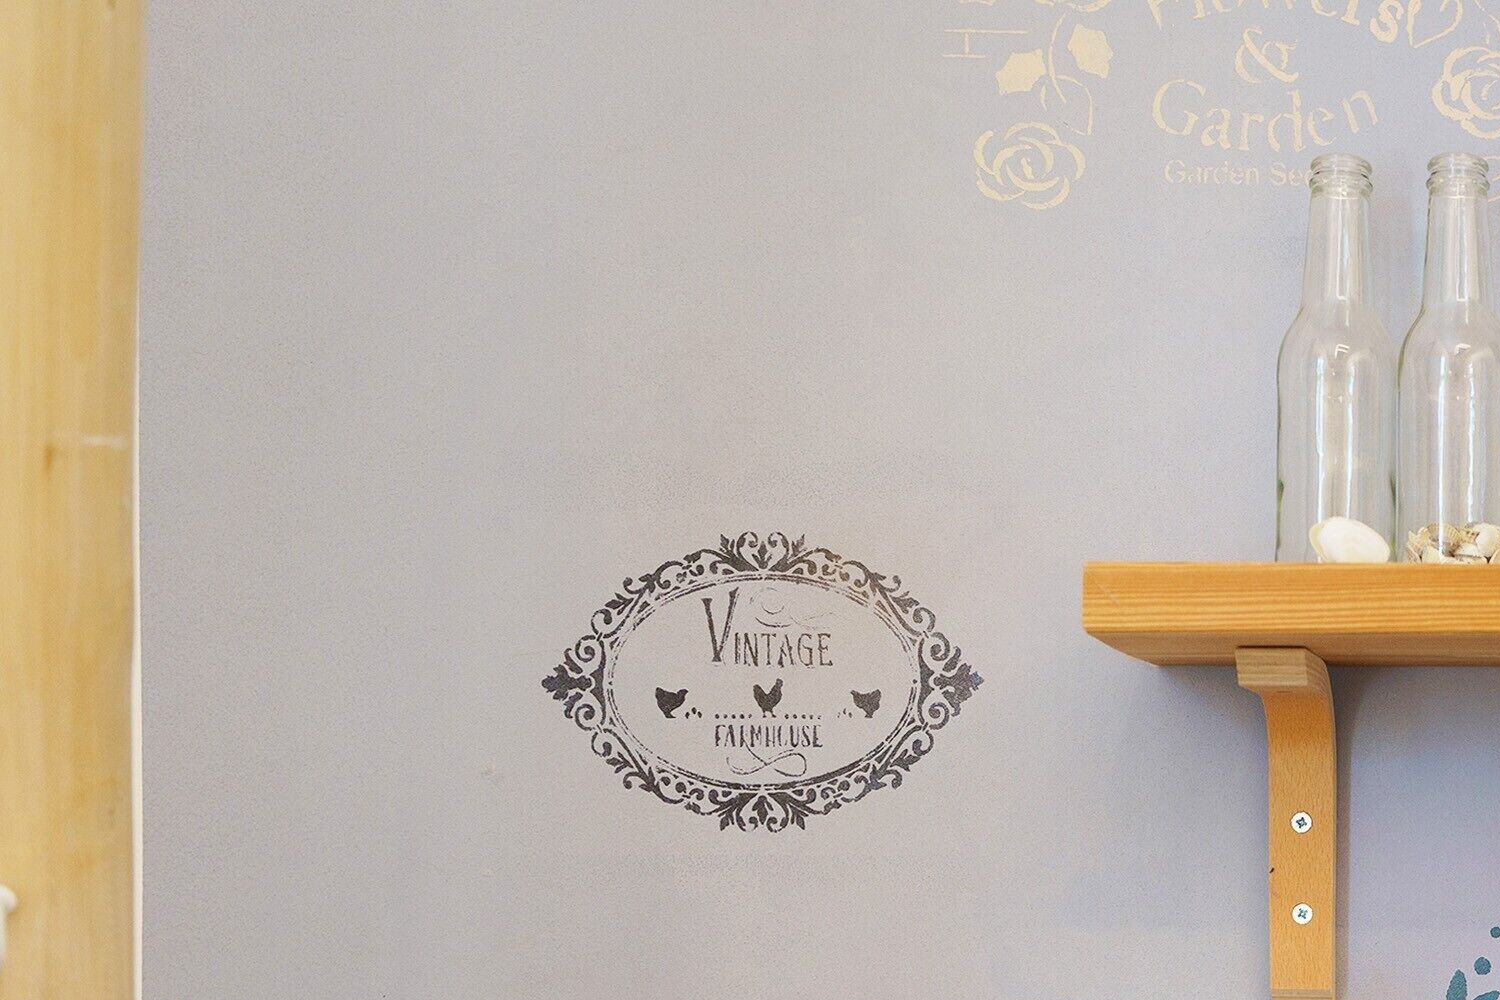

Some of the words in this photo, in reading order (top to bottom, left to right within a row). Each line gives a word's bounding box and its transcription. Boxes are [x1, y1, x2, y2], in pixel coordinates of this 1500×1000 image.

[1235, 26, 1299, 84] &
[1151, 79, 1383, 153] Garden
[1163, 160, 1260, 186] Garden
[714, 724, 823, 751] FARMHOUSE
